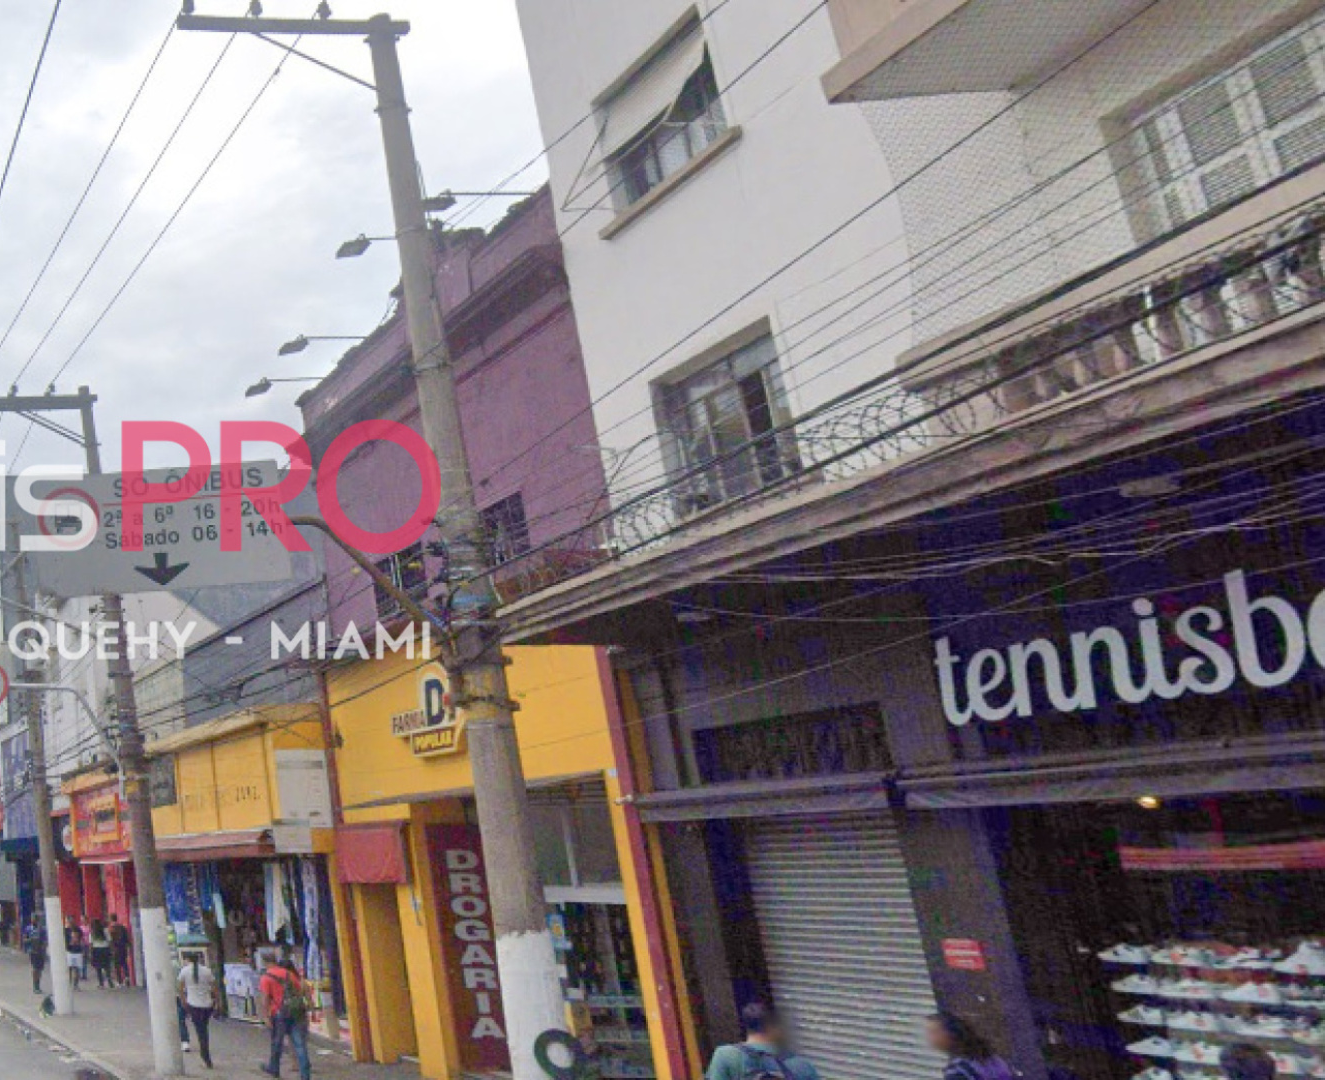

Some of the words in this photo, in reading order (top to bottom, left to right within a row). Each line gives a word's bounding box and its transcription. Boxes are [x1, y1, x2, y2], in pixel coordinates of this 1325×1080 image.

[165, 467, 263, 494] ÔNIBUS
[194, 504, 216, 520] 16
[241, 498, 281, 517] 20h
[105, 529, 180, 549] Sábado
[192, 526, 218, 541] 06
[246, 520, 283, 538] 14h
[446, 849, 506, 1039] DROGARIA
